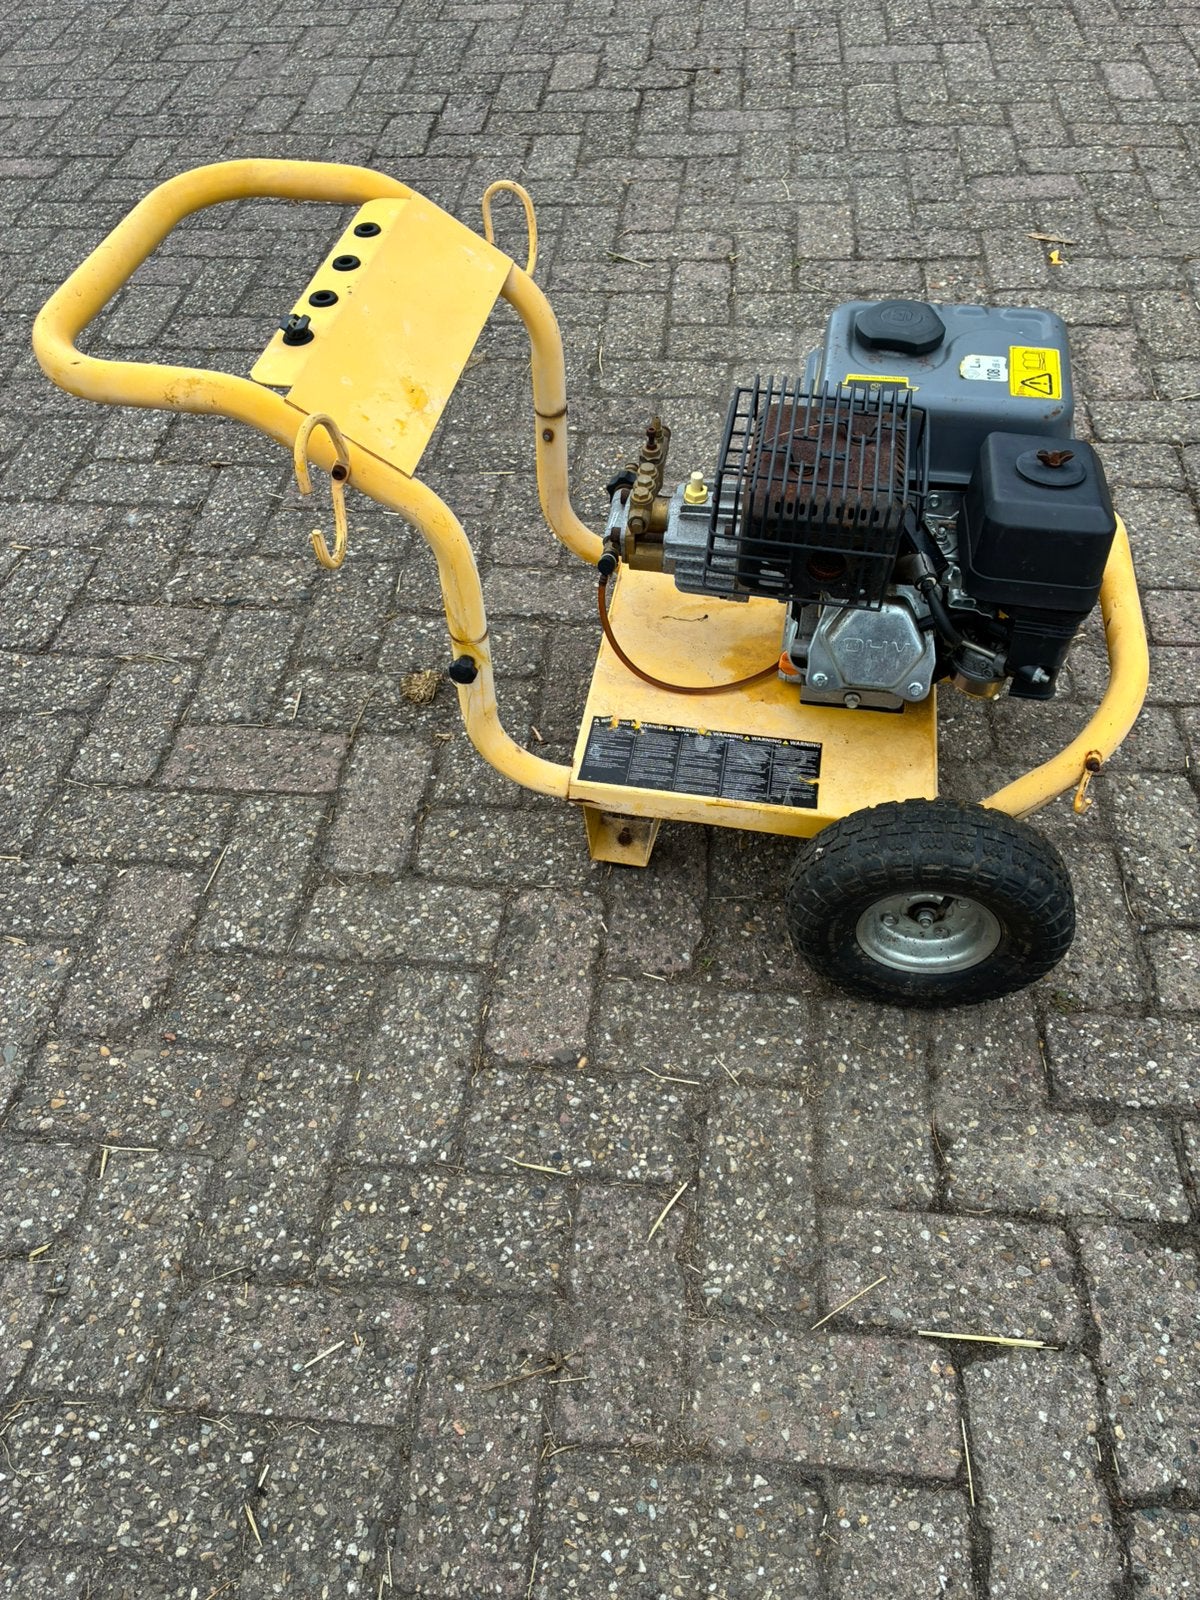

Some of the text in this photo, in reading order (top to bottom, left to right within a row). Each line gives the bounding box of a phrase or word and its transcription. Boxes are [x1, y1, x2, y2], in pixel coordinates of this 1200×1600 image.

[986, 368, 1000, 380] 108
[843, 637, 911, 656] OHV
[713, 732, 744, 740] WARNING
[750, 736, 782, 744] WARNING
[790, 741, 821, 749] WARNING
